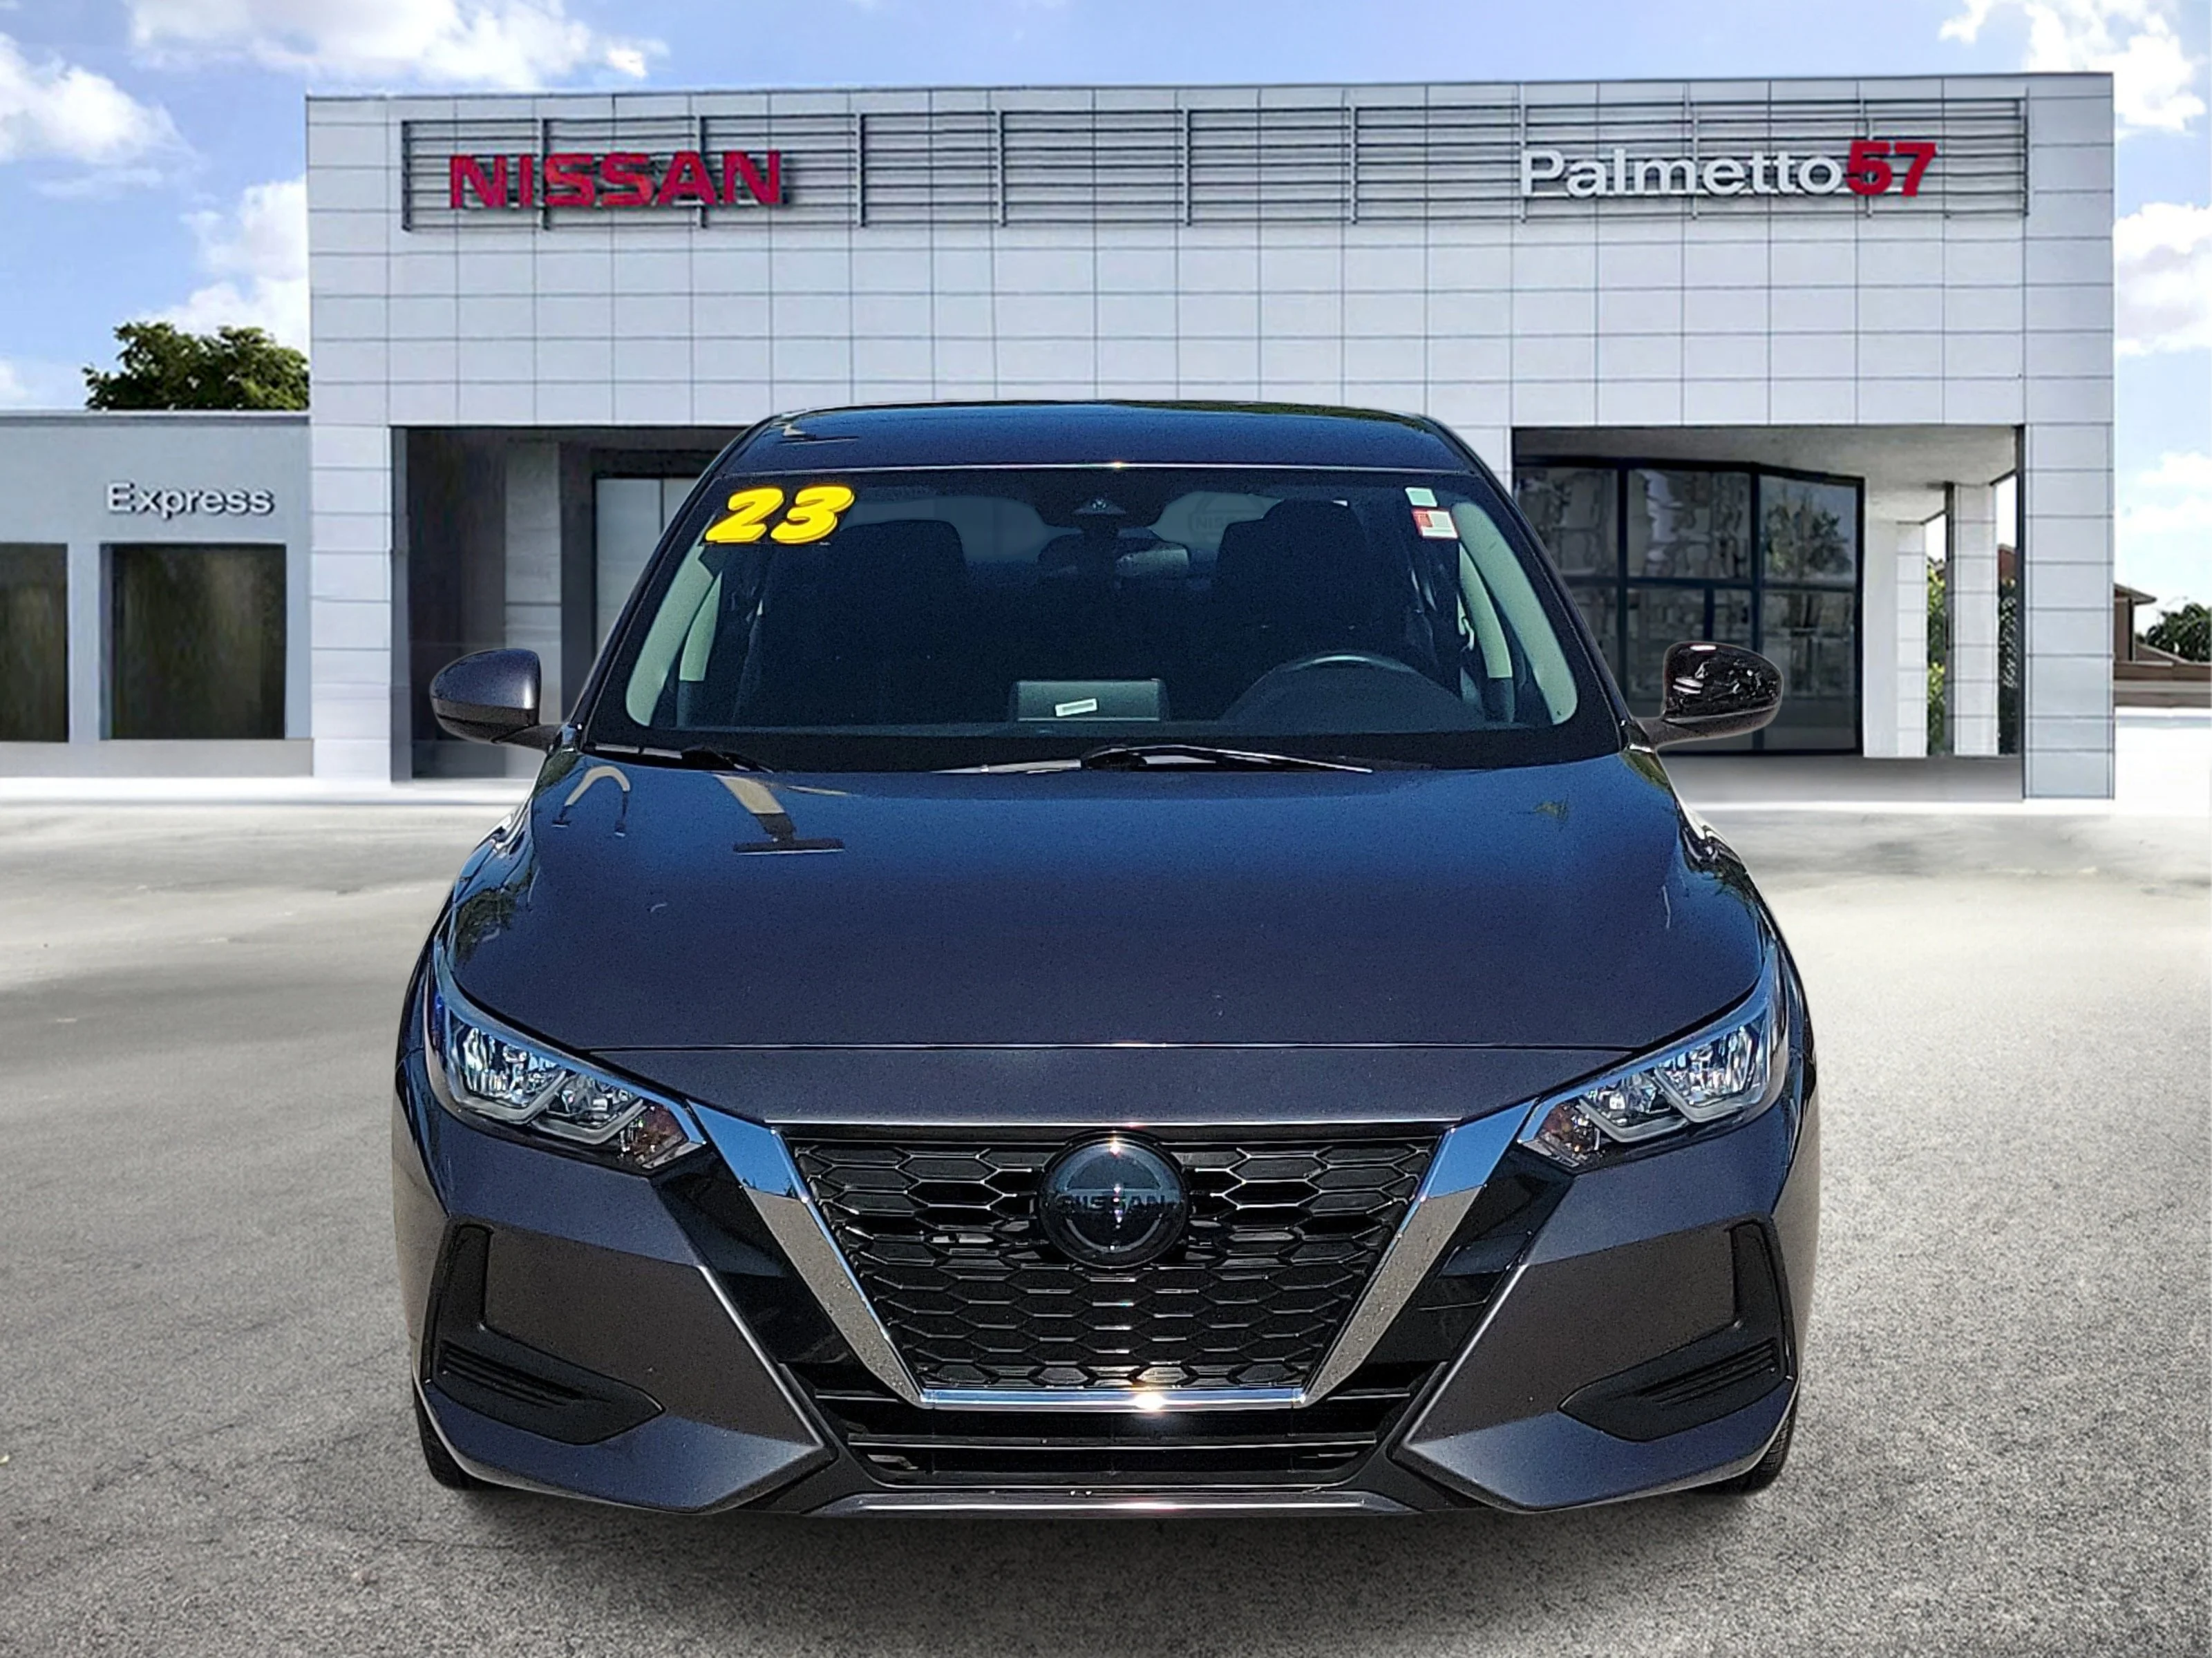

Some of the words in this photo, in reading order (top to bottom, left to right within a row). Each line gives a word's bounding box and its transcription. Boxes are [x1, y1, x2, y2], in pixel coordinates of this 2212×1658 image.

[450, 150, 781, 207] NISSAN
[108, 483, 274, 519] Express
[705, 485, 855, 544] 23
